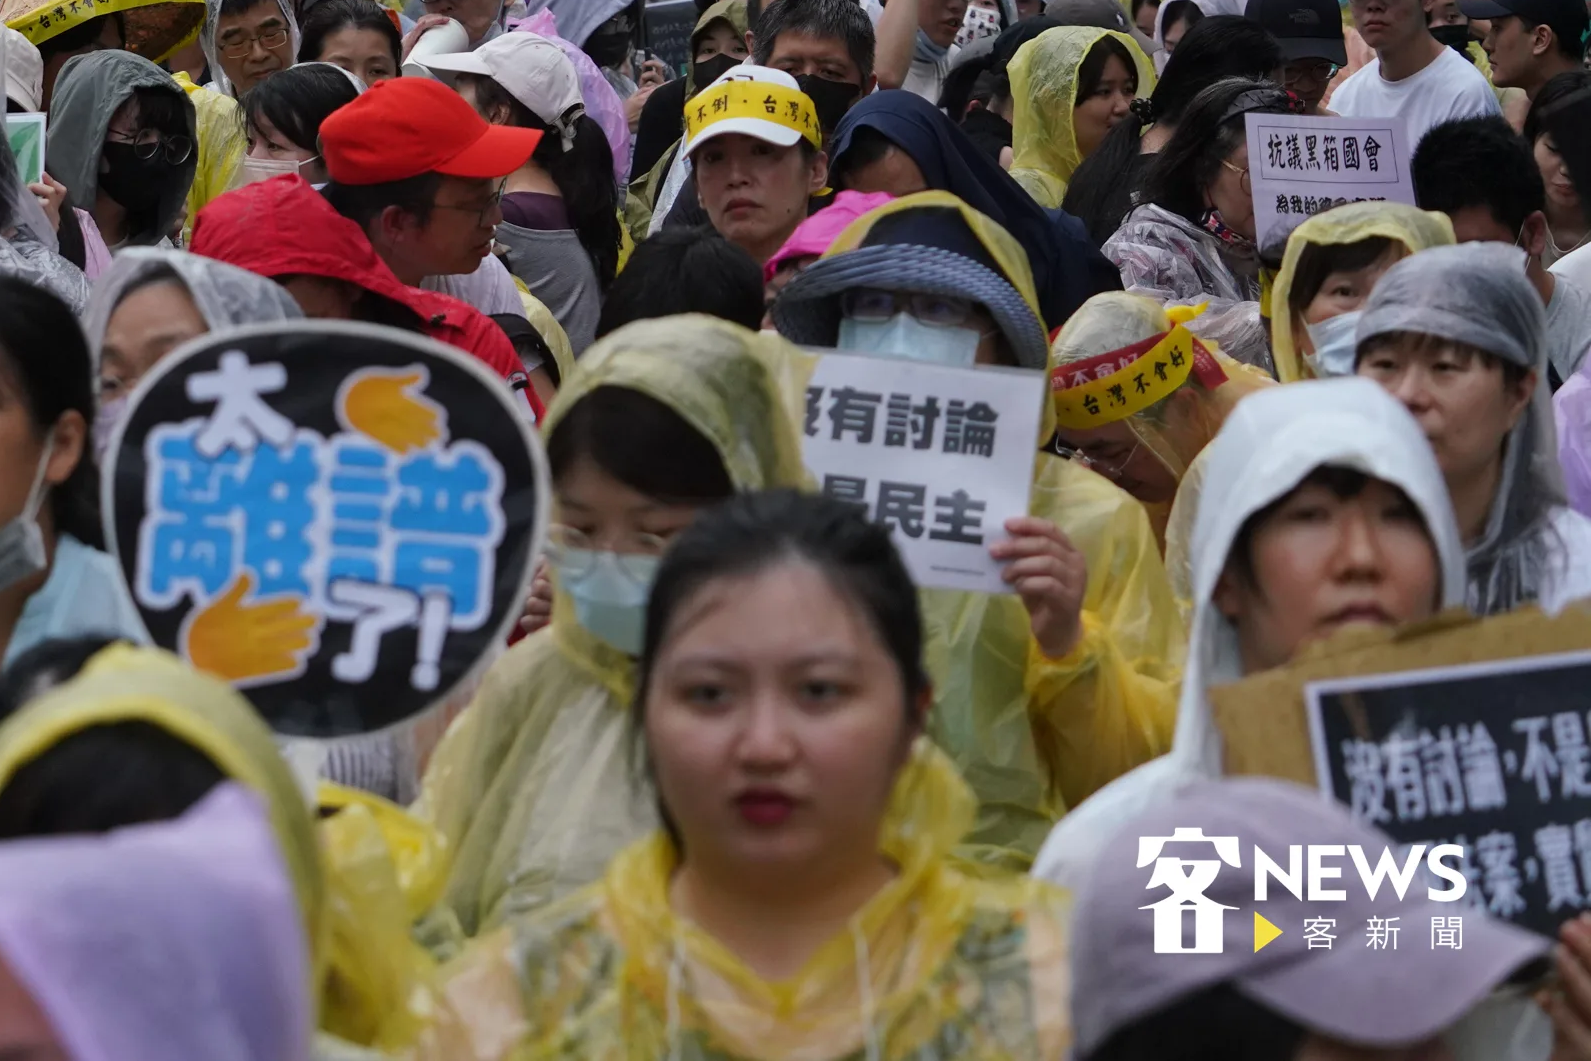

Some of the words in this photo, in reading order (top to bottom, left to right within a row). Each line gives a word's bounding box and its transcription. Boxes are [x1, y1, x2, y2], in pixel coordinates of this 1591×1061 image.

[1267, 133, 1382, 172] 抗議黑箱國會
[186, 350, 295, 458] 太
[143, 422, 502, 627] 離譜
